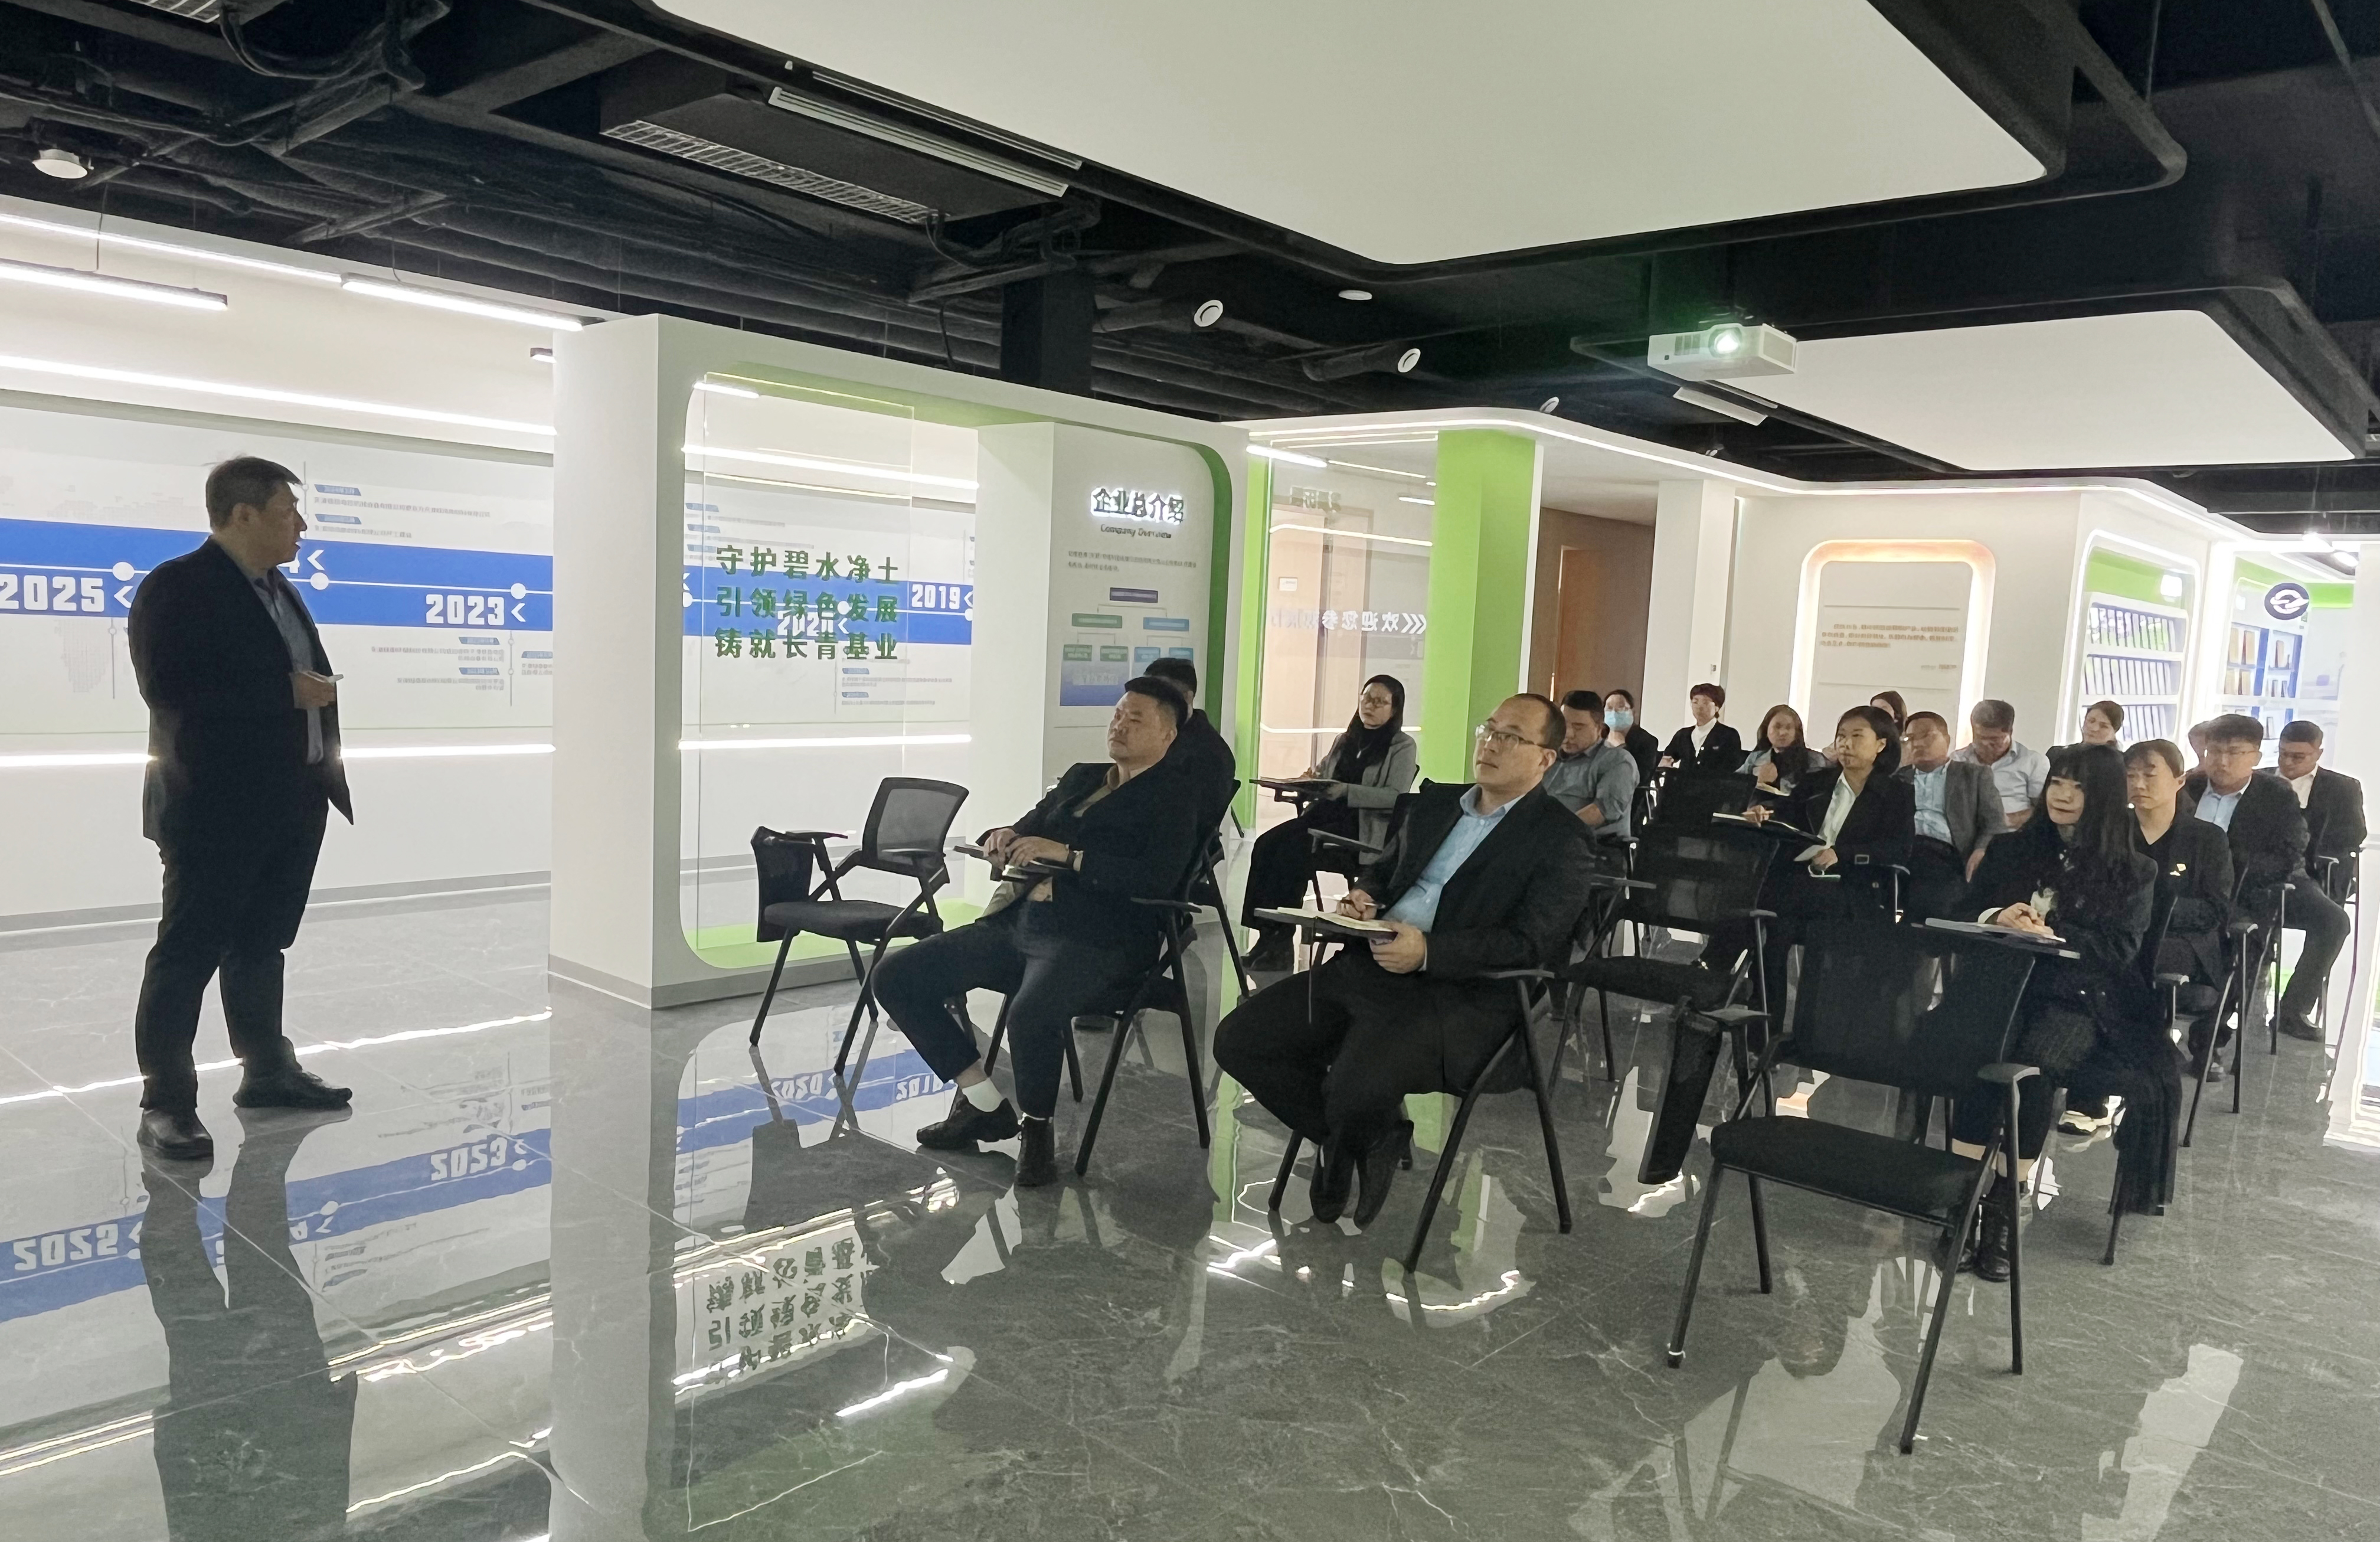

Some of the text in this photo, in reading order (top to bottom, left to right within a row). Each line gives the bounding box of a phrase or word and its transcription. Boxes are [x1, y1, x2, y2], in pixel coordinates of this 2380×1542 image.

[716, 544, 900, 584] 守护碧水净土
[0, 574, 104, 612] 2025
[426, 594, 505, 626] 2023
[716, 586, 898, 622] 引领绿色发展
[911, 584, 961, 610] 2019
[714, 627, 898, 660] 铸就长青基业
